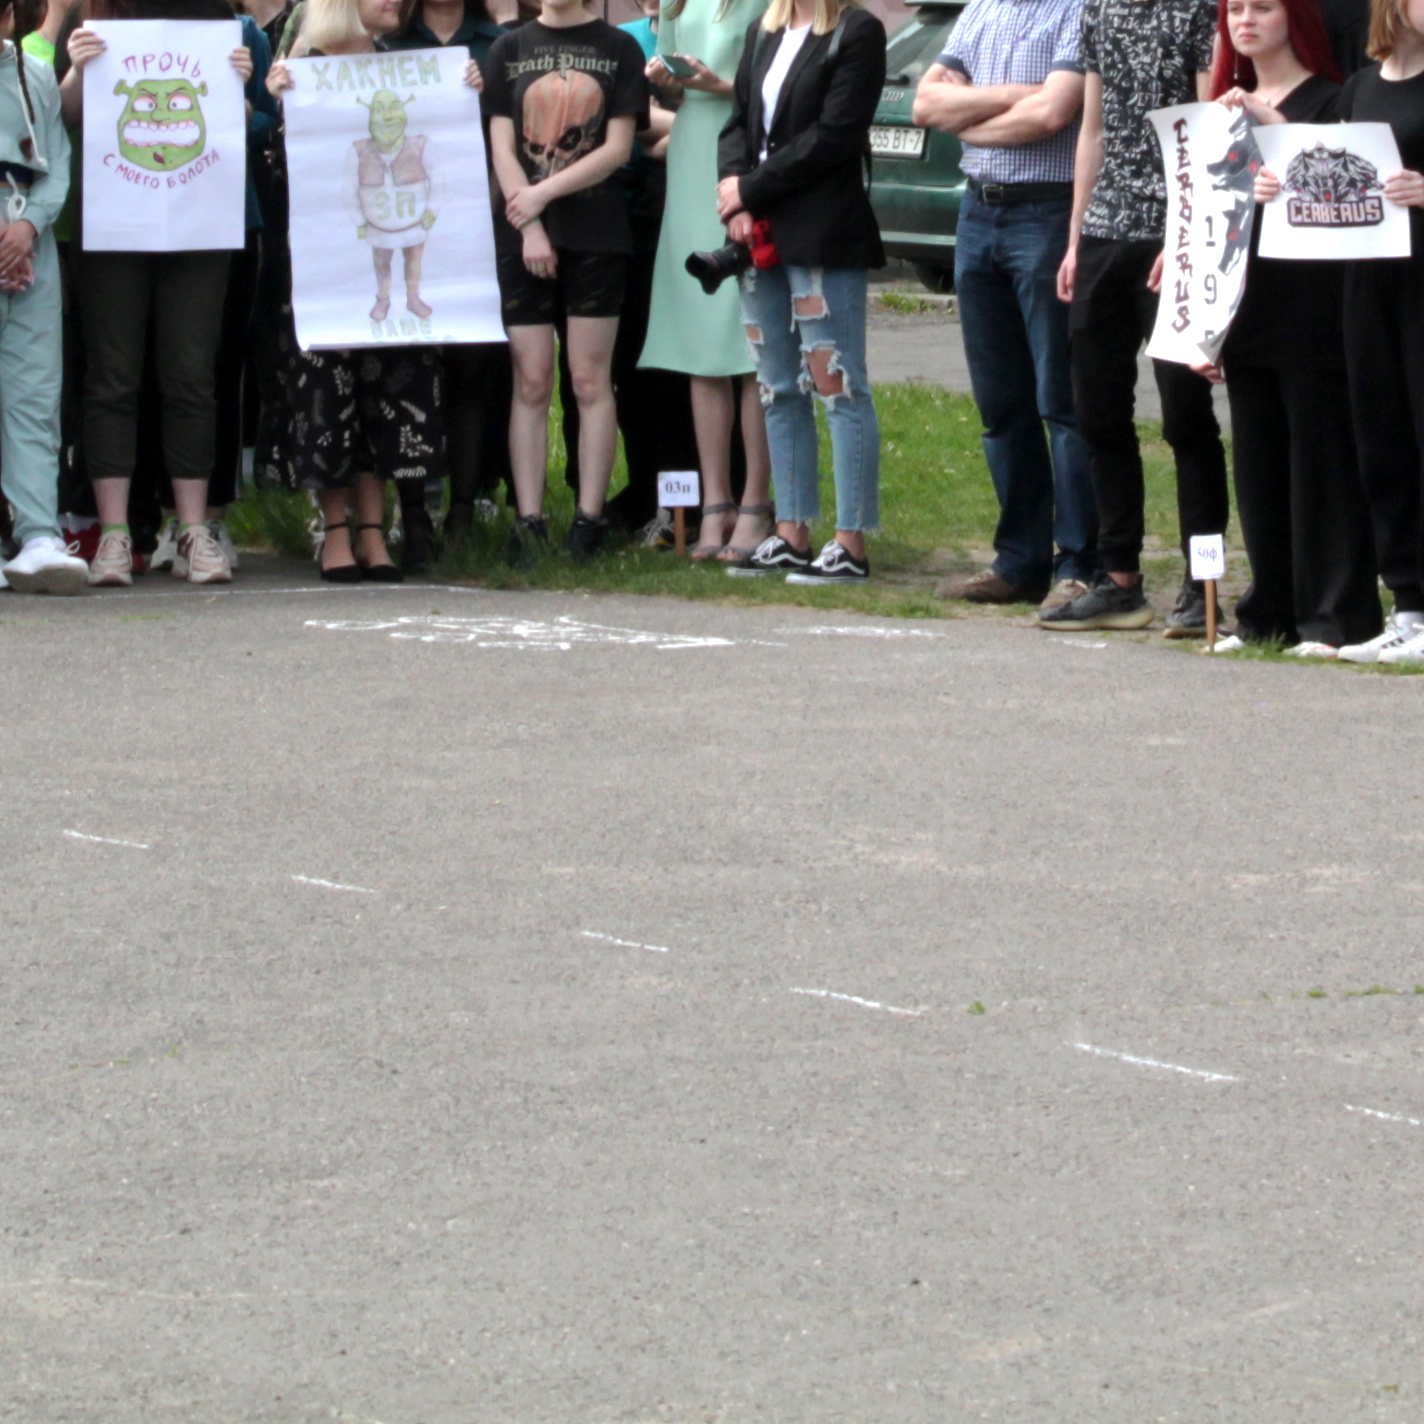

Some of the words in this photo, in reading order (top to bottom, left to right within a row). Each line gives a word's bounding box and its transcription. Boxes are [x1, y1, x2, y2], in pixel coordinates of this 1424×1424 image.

[122, 51, 202, 78] ПРОЧЬ
[534, 44, 554, 56] FIVE
[557, 43, 596, 55] FINGER
[311, 53, 442, 92] ХАКНЕМ
[103, 153, 116, 166] С
[114, 163, 160, 189] МОЕГО
[166, 148, 220, 189] БОЛОТА
[1172, 117, 1194, 334] CERBERUS
